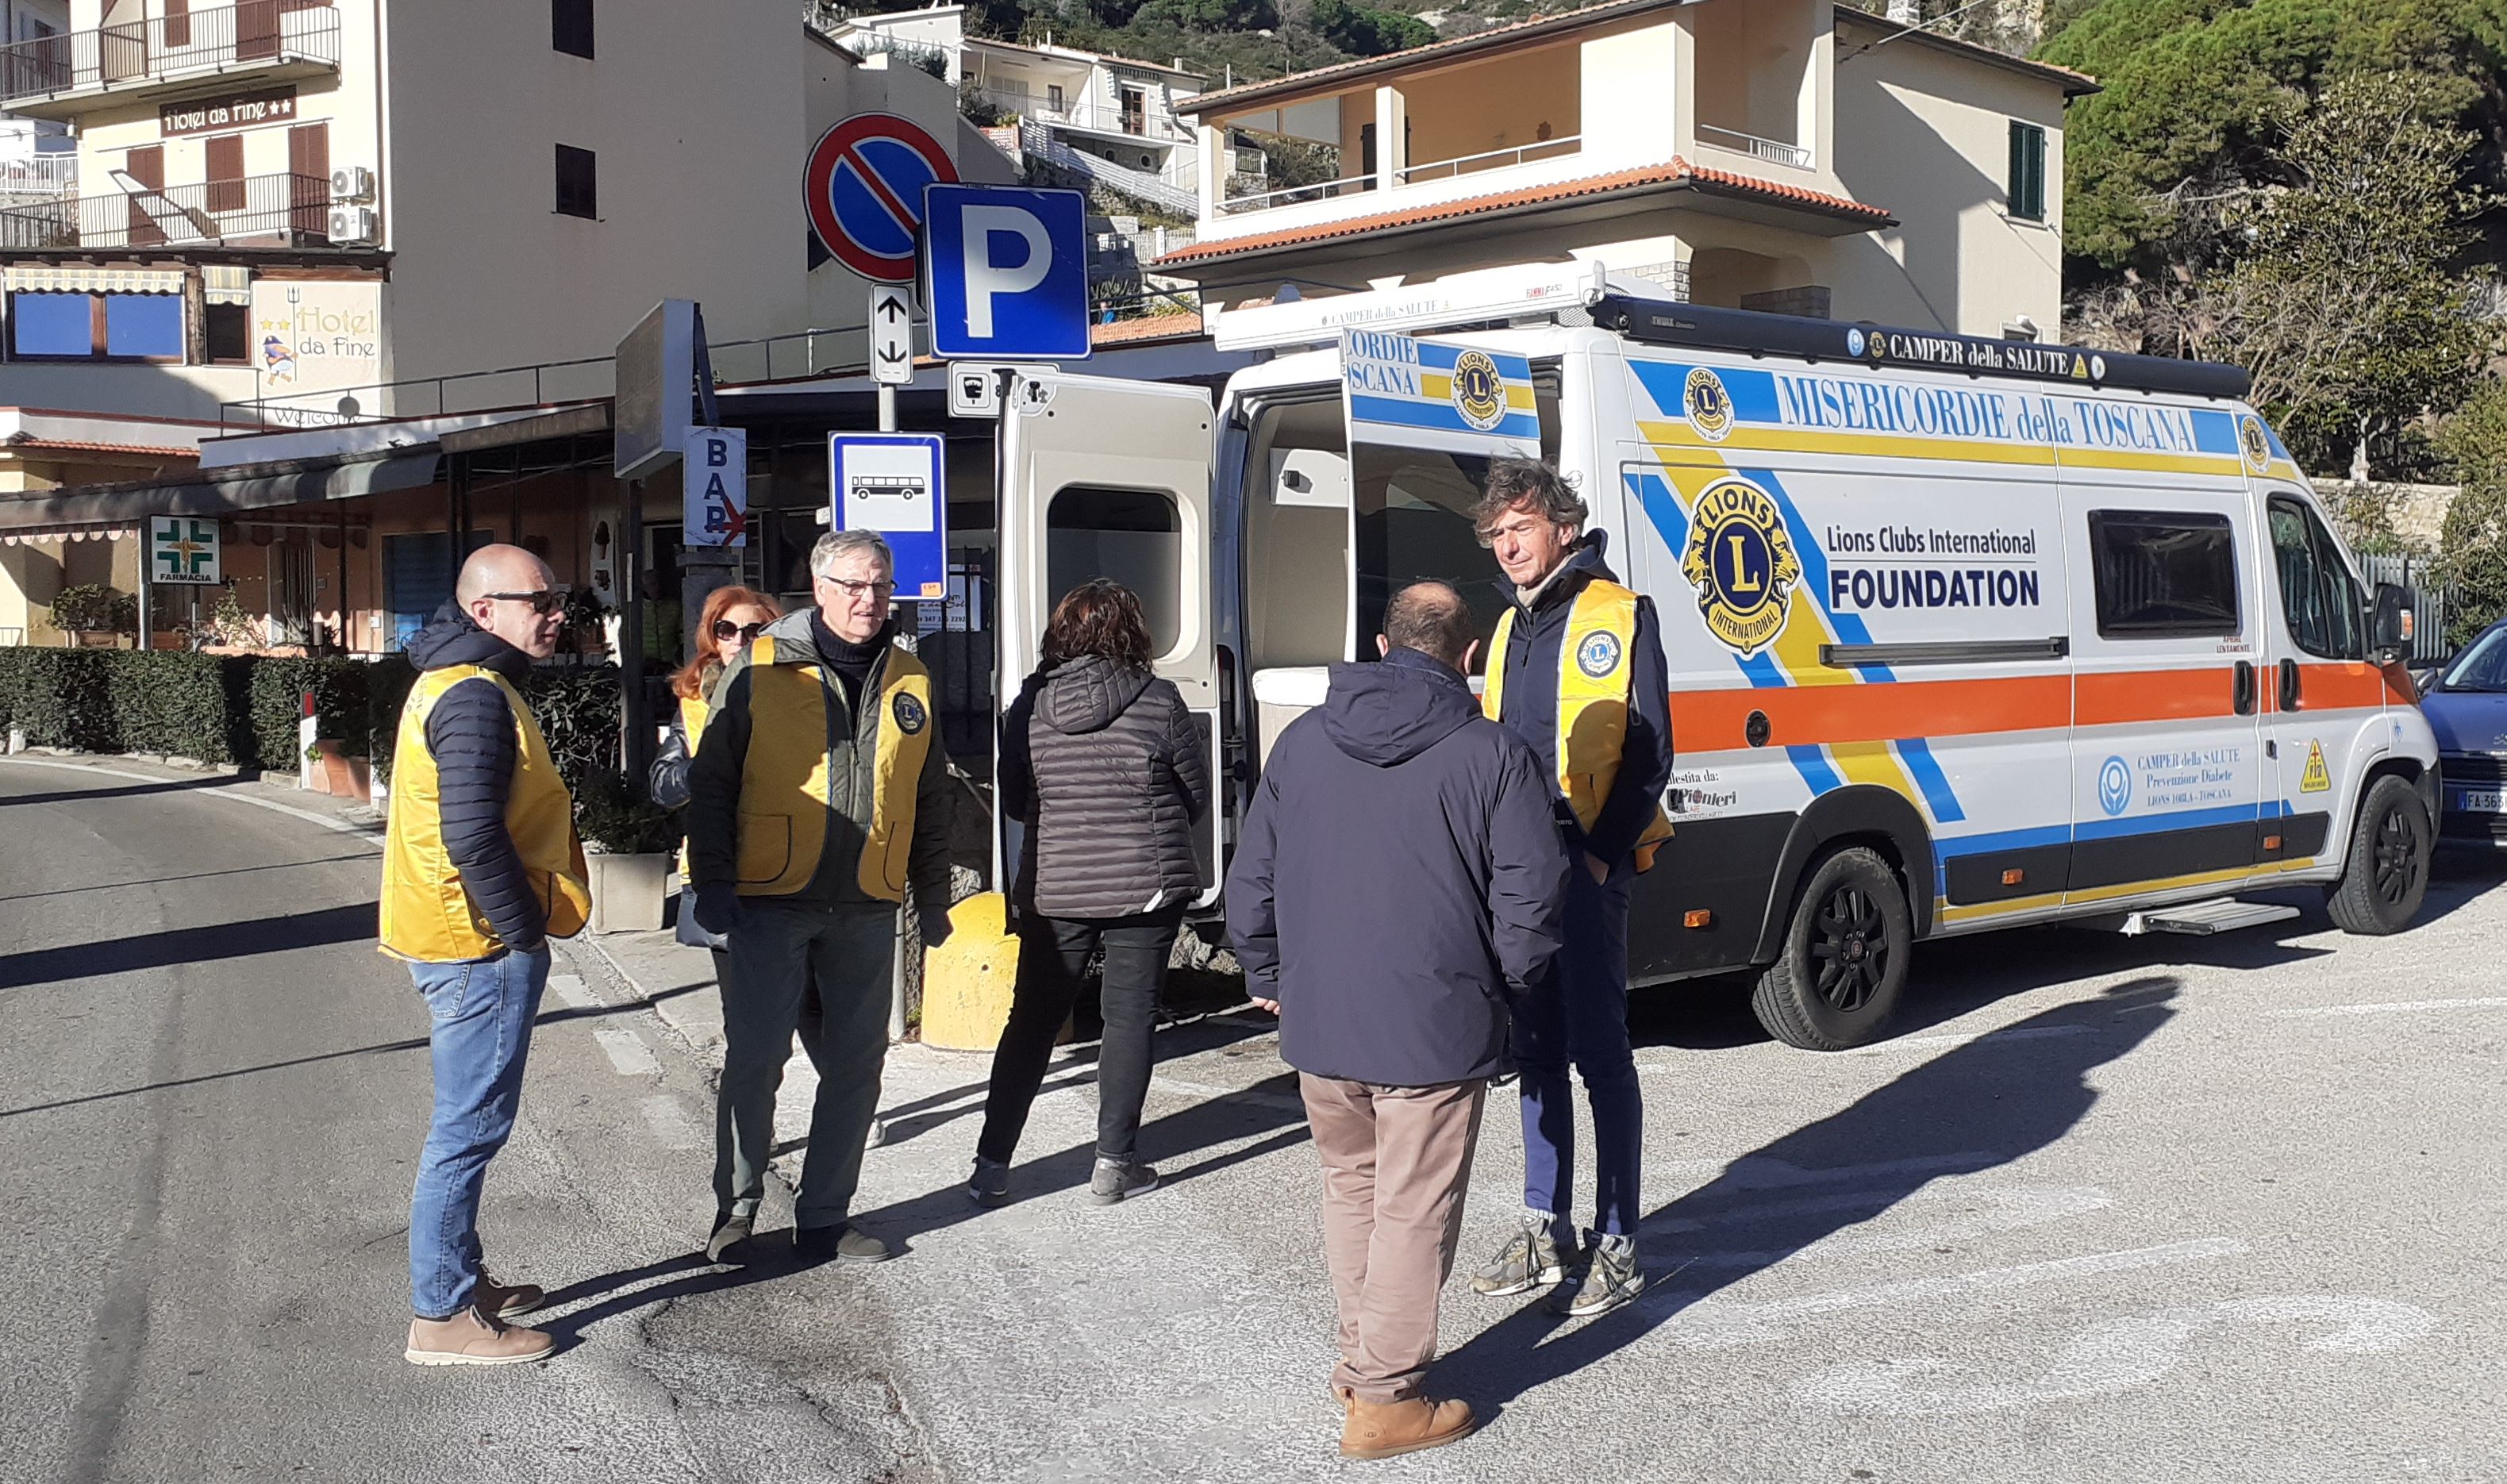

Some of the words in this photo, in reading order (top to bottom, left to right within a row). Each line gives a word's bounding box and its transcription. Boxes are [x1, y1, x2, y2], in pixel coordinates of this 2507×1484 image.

[209, 103, 230, 125] da
[962, 204, 1052, 338] P
[297, 306, 375, 336] Hotel
[1332, 309, 1373, 325] CAMPER
[1375, 306, 1396, 319] della
[1398, 300, 1438, 316] SALUTE
[300, 336, 325, 355] da
[333, 336, 375, 358] Fine
[1890, 335, 1963, 365] CAMPER
[1968, 343, 2002, 368] della
[2007, 347, 2069, 375] SALUTE
[1462, 354, 1490, 370] LIONS
[1347, 361, 1416, 395] SCANA
[1472, 372, 1486, 397] L
[1691, 372, 1717, 386] LIONS
[1701, 389, 1715, 410] L
[1778, 375, 2012, 440] MISERICORDIE
[2017, 395, 2074, 444] della
[2074, 402, 2197, 452] TOSCANA
[704, 439, 727, 534] BAR
[1704, 488, 1770, 525] LIONS
[1827, 525, 1875, 552] Lions
[1879, 525, 1925, 553] Clubs
[1929, 529, 2036, 554] International
[1728, 536, 1760, 592] L
[160, 573, 211, 582] FARMACIA
[1831, 569, 2040, 609] FOUNDATION
[1713, 609, 1778, 640] INTERNATIONAL
[2138, 753, 2179, 770] CAMPER
[2182, 751, 2201, 767] della
[2204, 748, 2240, 764] SALUTE
[1704, 769, 1719, 782] da:
[2147, 772, 2198, 788] Prevenzione
[2201, 767, 2232, 783] Diabete
[2147, 794, 2170, 806] LIONS
[2200, 788, 2232, 801] TOSCANA
[2467, 794, 2481, 808] FA
